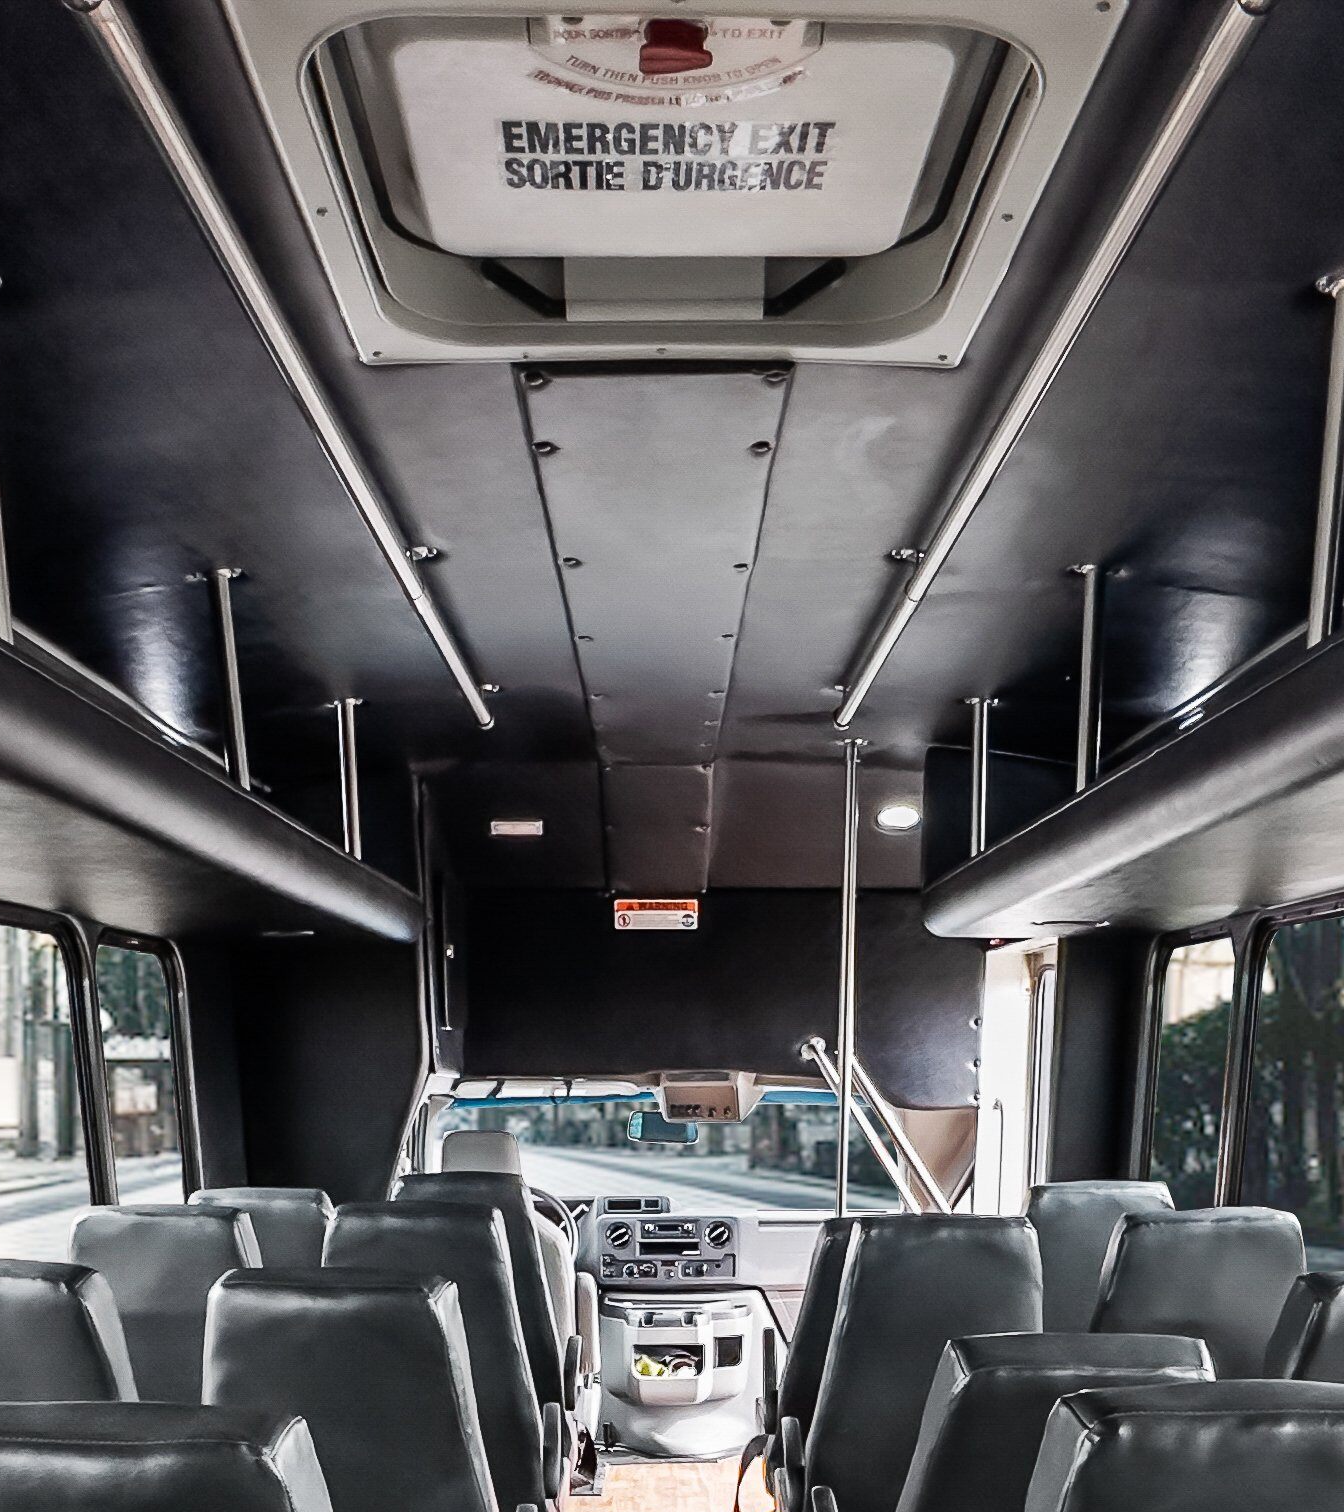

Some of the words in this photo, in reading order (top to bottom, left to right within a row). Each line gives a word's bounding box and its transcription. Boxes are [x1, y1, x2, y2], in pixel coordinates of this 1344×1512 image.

[721, 28, 742, 39] TO
[745, 28, 785, 39] EXIT
[566, 55, 600, 76] TURN
[603, 68, 639, 84] THEN
[641, 74, 678, 86] PUSH
[683, 73, 721, 85] KNOB
[727, 69, 743, 80] TO
[745, 56, 782, 76] OPEN
[502, 121, 738, 156] EMERGENCY
[749, 121, 837, 155] EXIT
[505, 158, 625, 192] SORTIE
[642, 160, 829, 192] D'URGENCE
